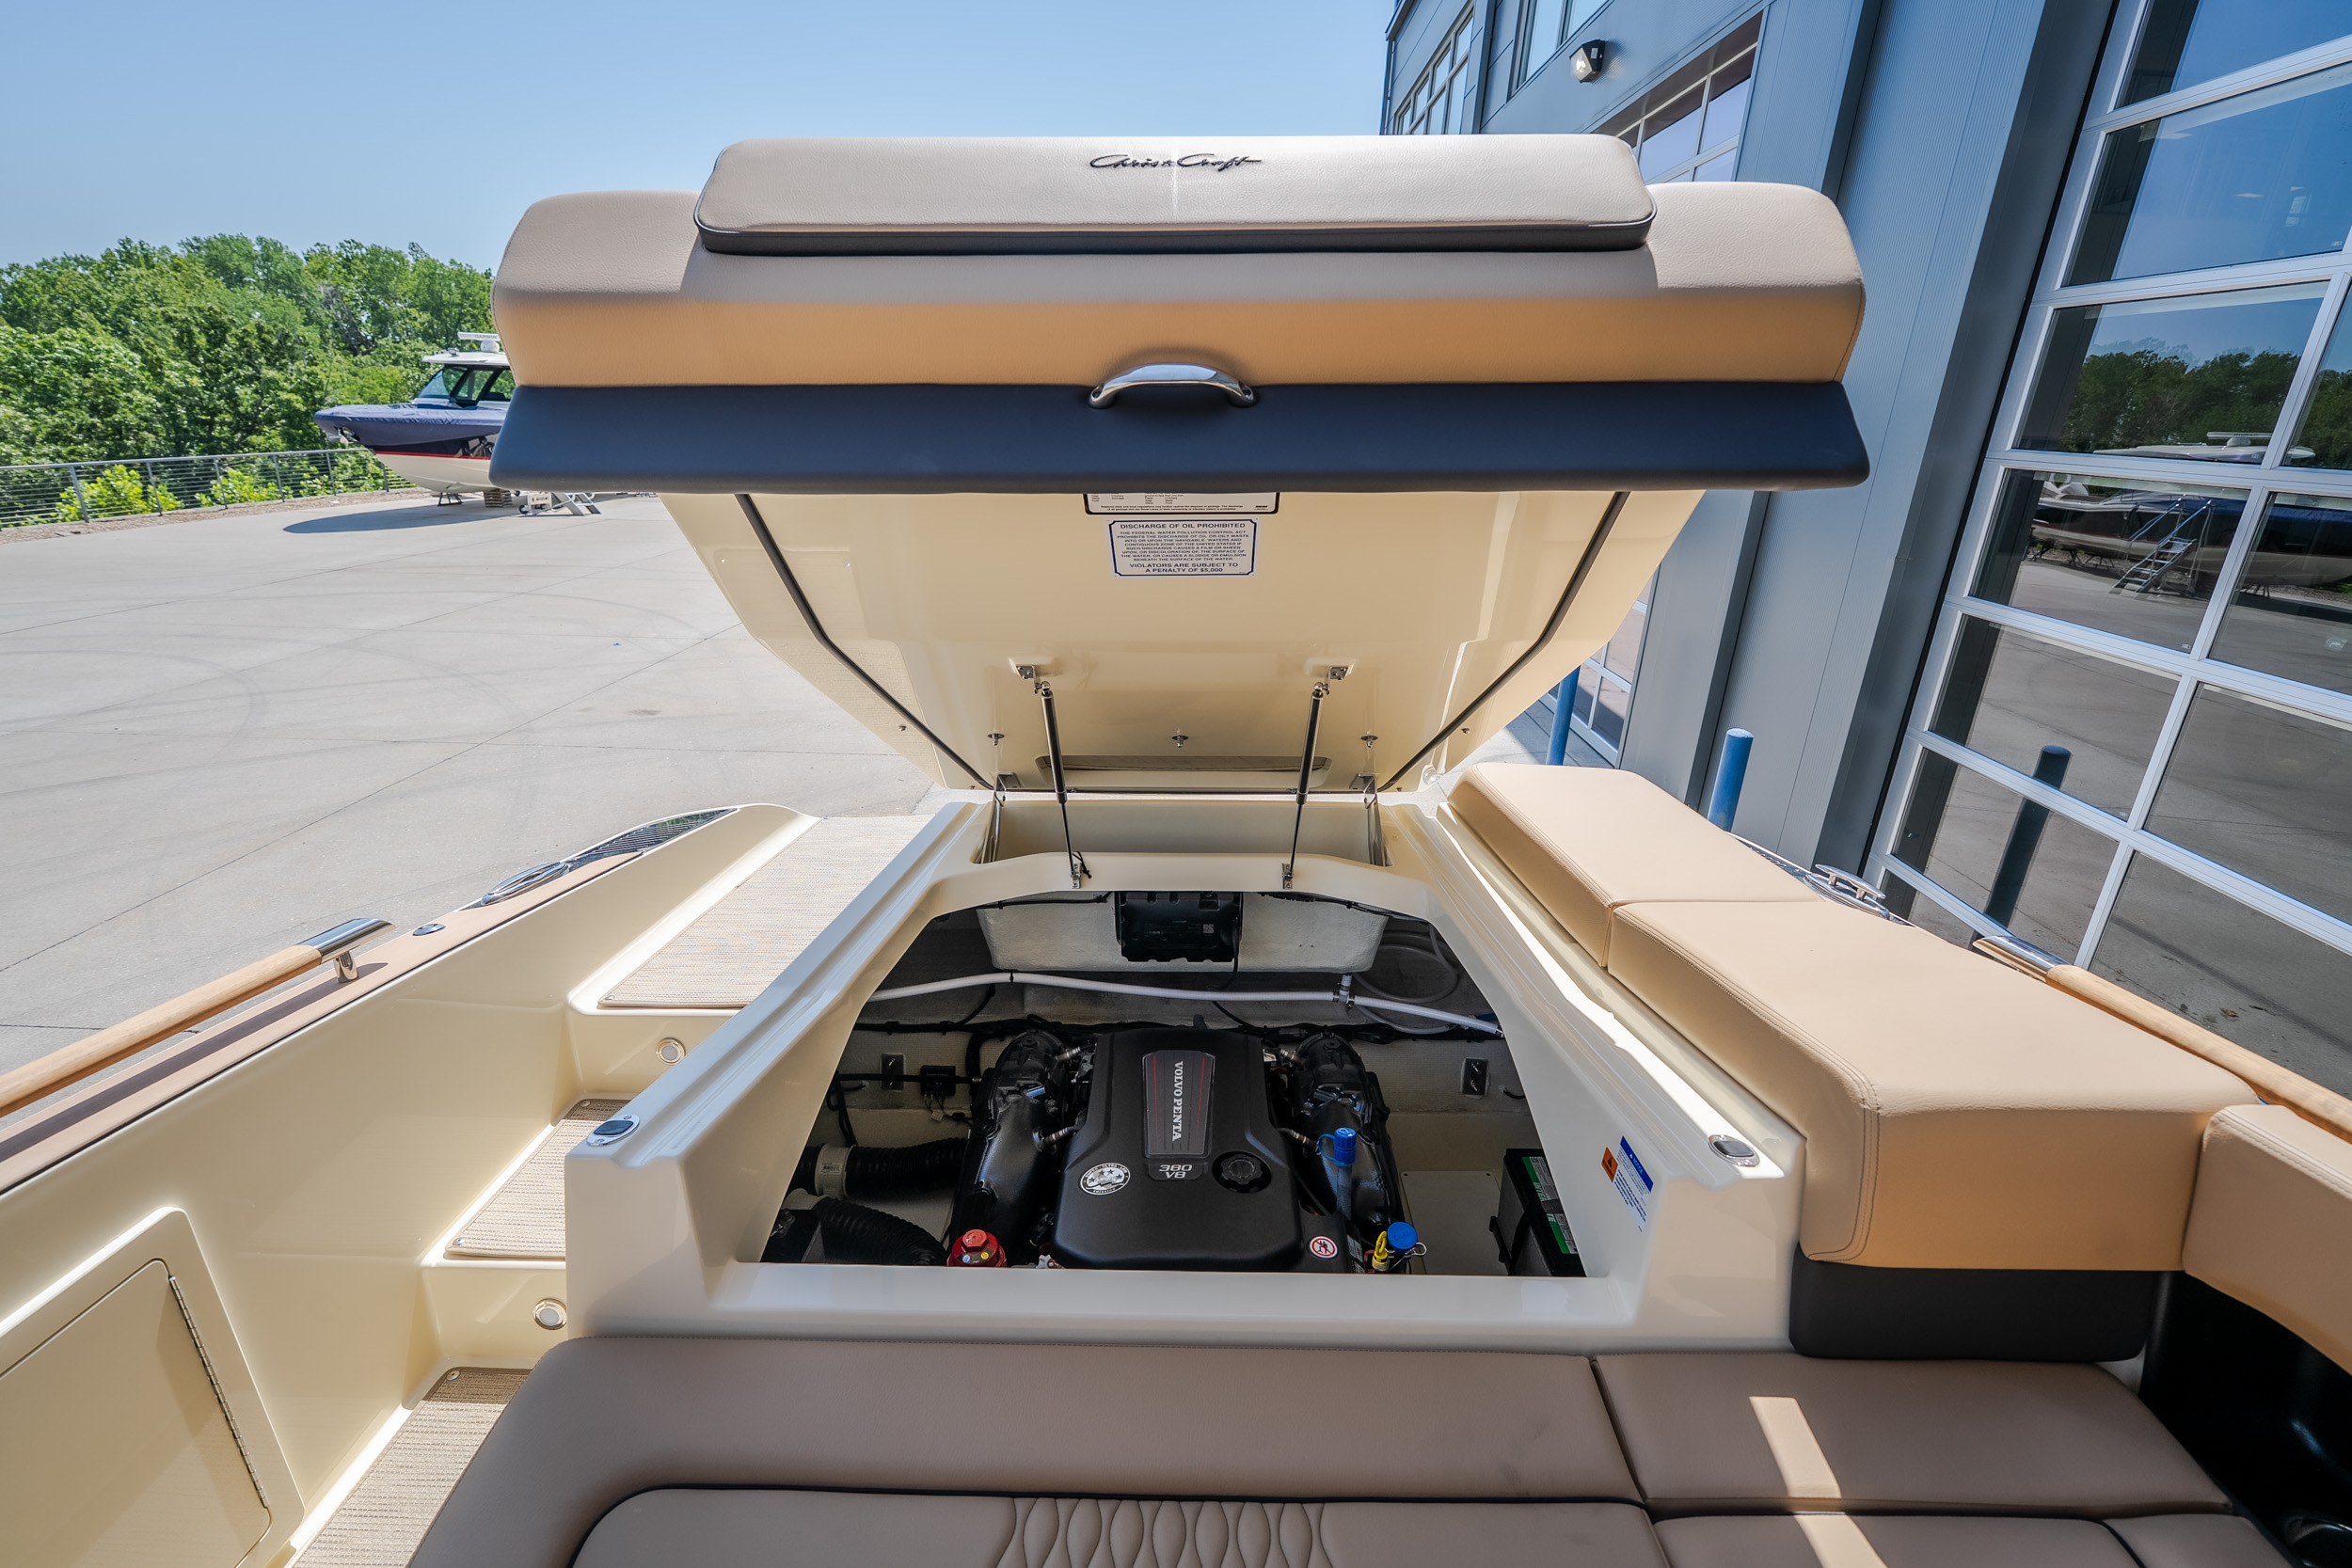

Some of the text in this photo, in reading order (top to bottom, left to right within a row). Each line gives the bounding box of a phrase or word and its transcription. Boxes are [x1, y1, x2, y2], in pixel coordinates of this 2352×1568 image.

[1172, 1061, 1183, 1141] VOLVO PENTA
[1533, 1181, 1557, 1223] INTERTE
